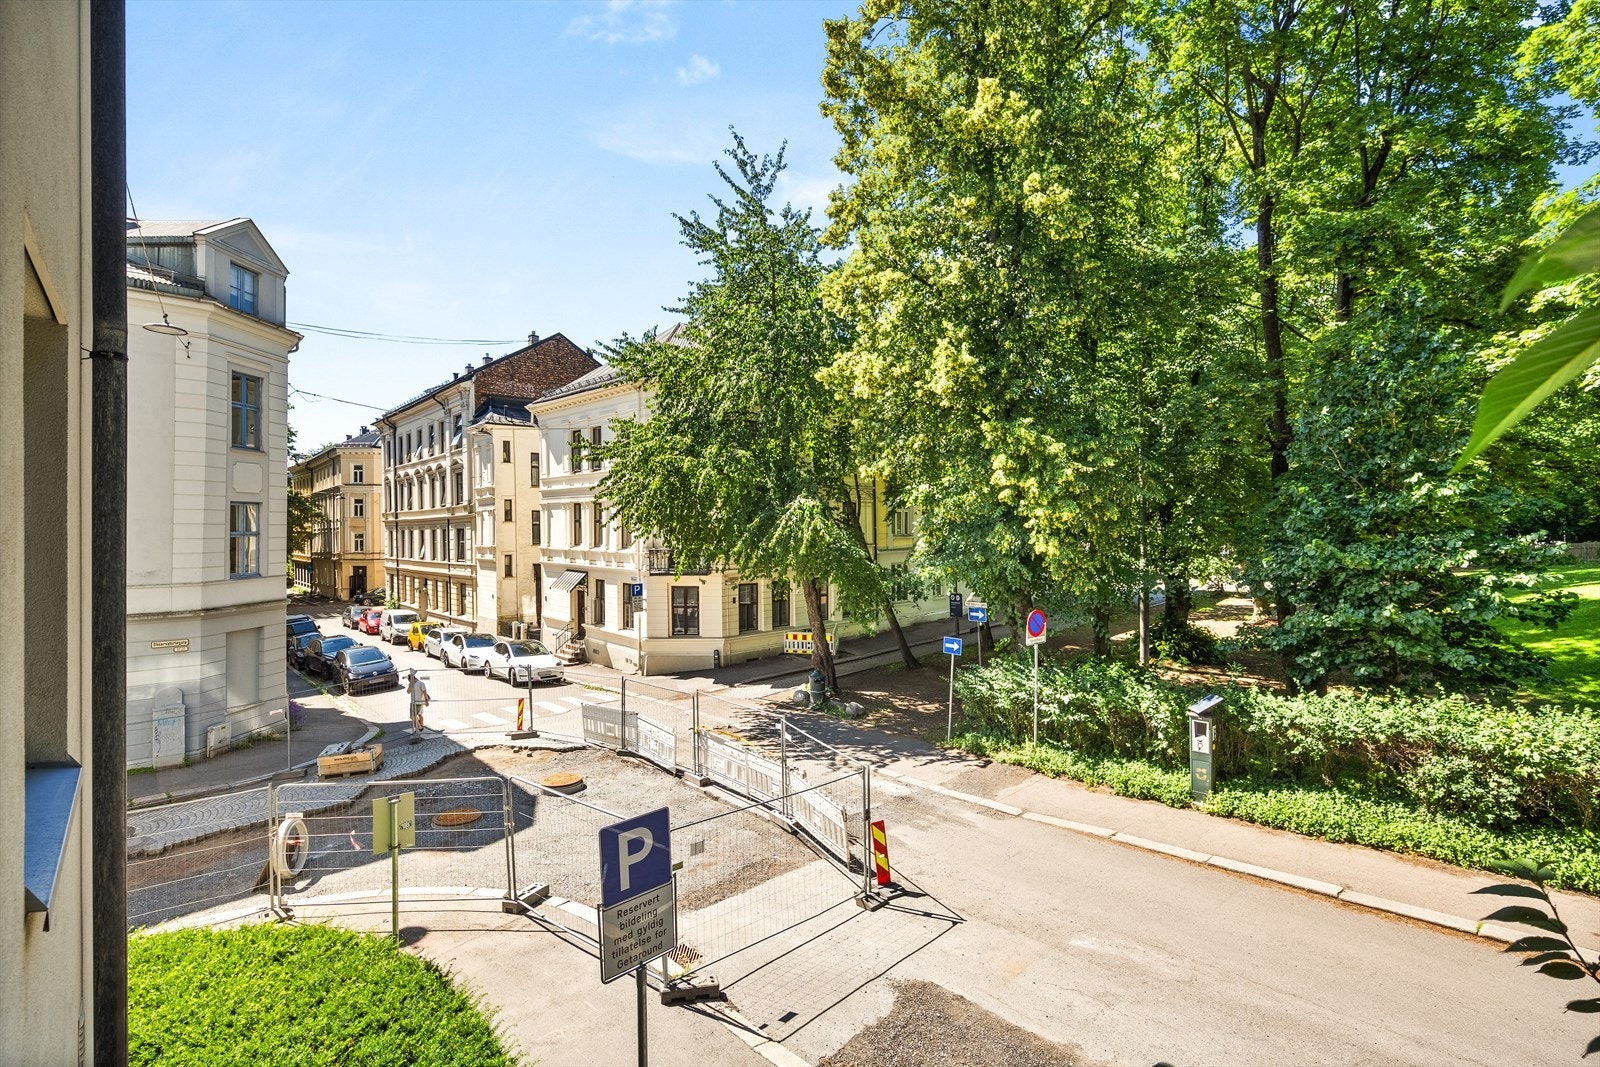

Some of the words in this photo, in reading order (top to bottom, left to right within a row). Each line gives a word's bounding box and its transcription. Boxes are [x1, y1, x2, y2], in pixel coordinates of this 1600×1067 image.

[634, 586, 640, 595] P
[618, 827, 653, 892] P
[617, 894, 660, 919] Reservert
[620, 908, 658, 931] bildeling
[612, 936, 652, 959] tillatelse
[655, 928, 667, 939] for
[614, 930, 633, 946] med
[637, 918, 664, 937] gyldig
[617, 940, 663, 969] Getaround
